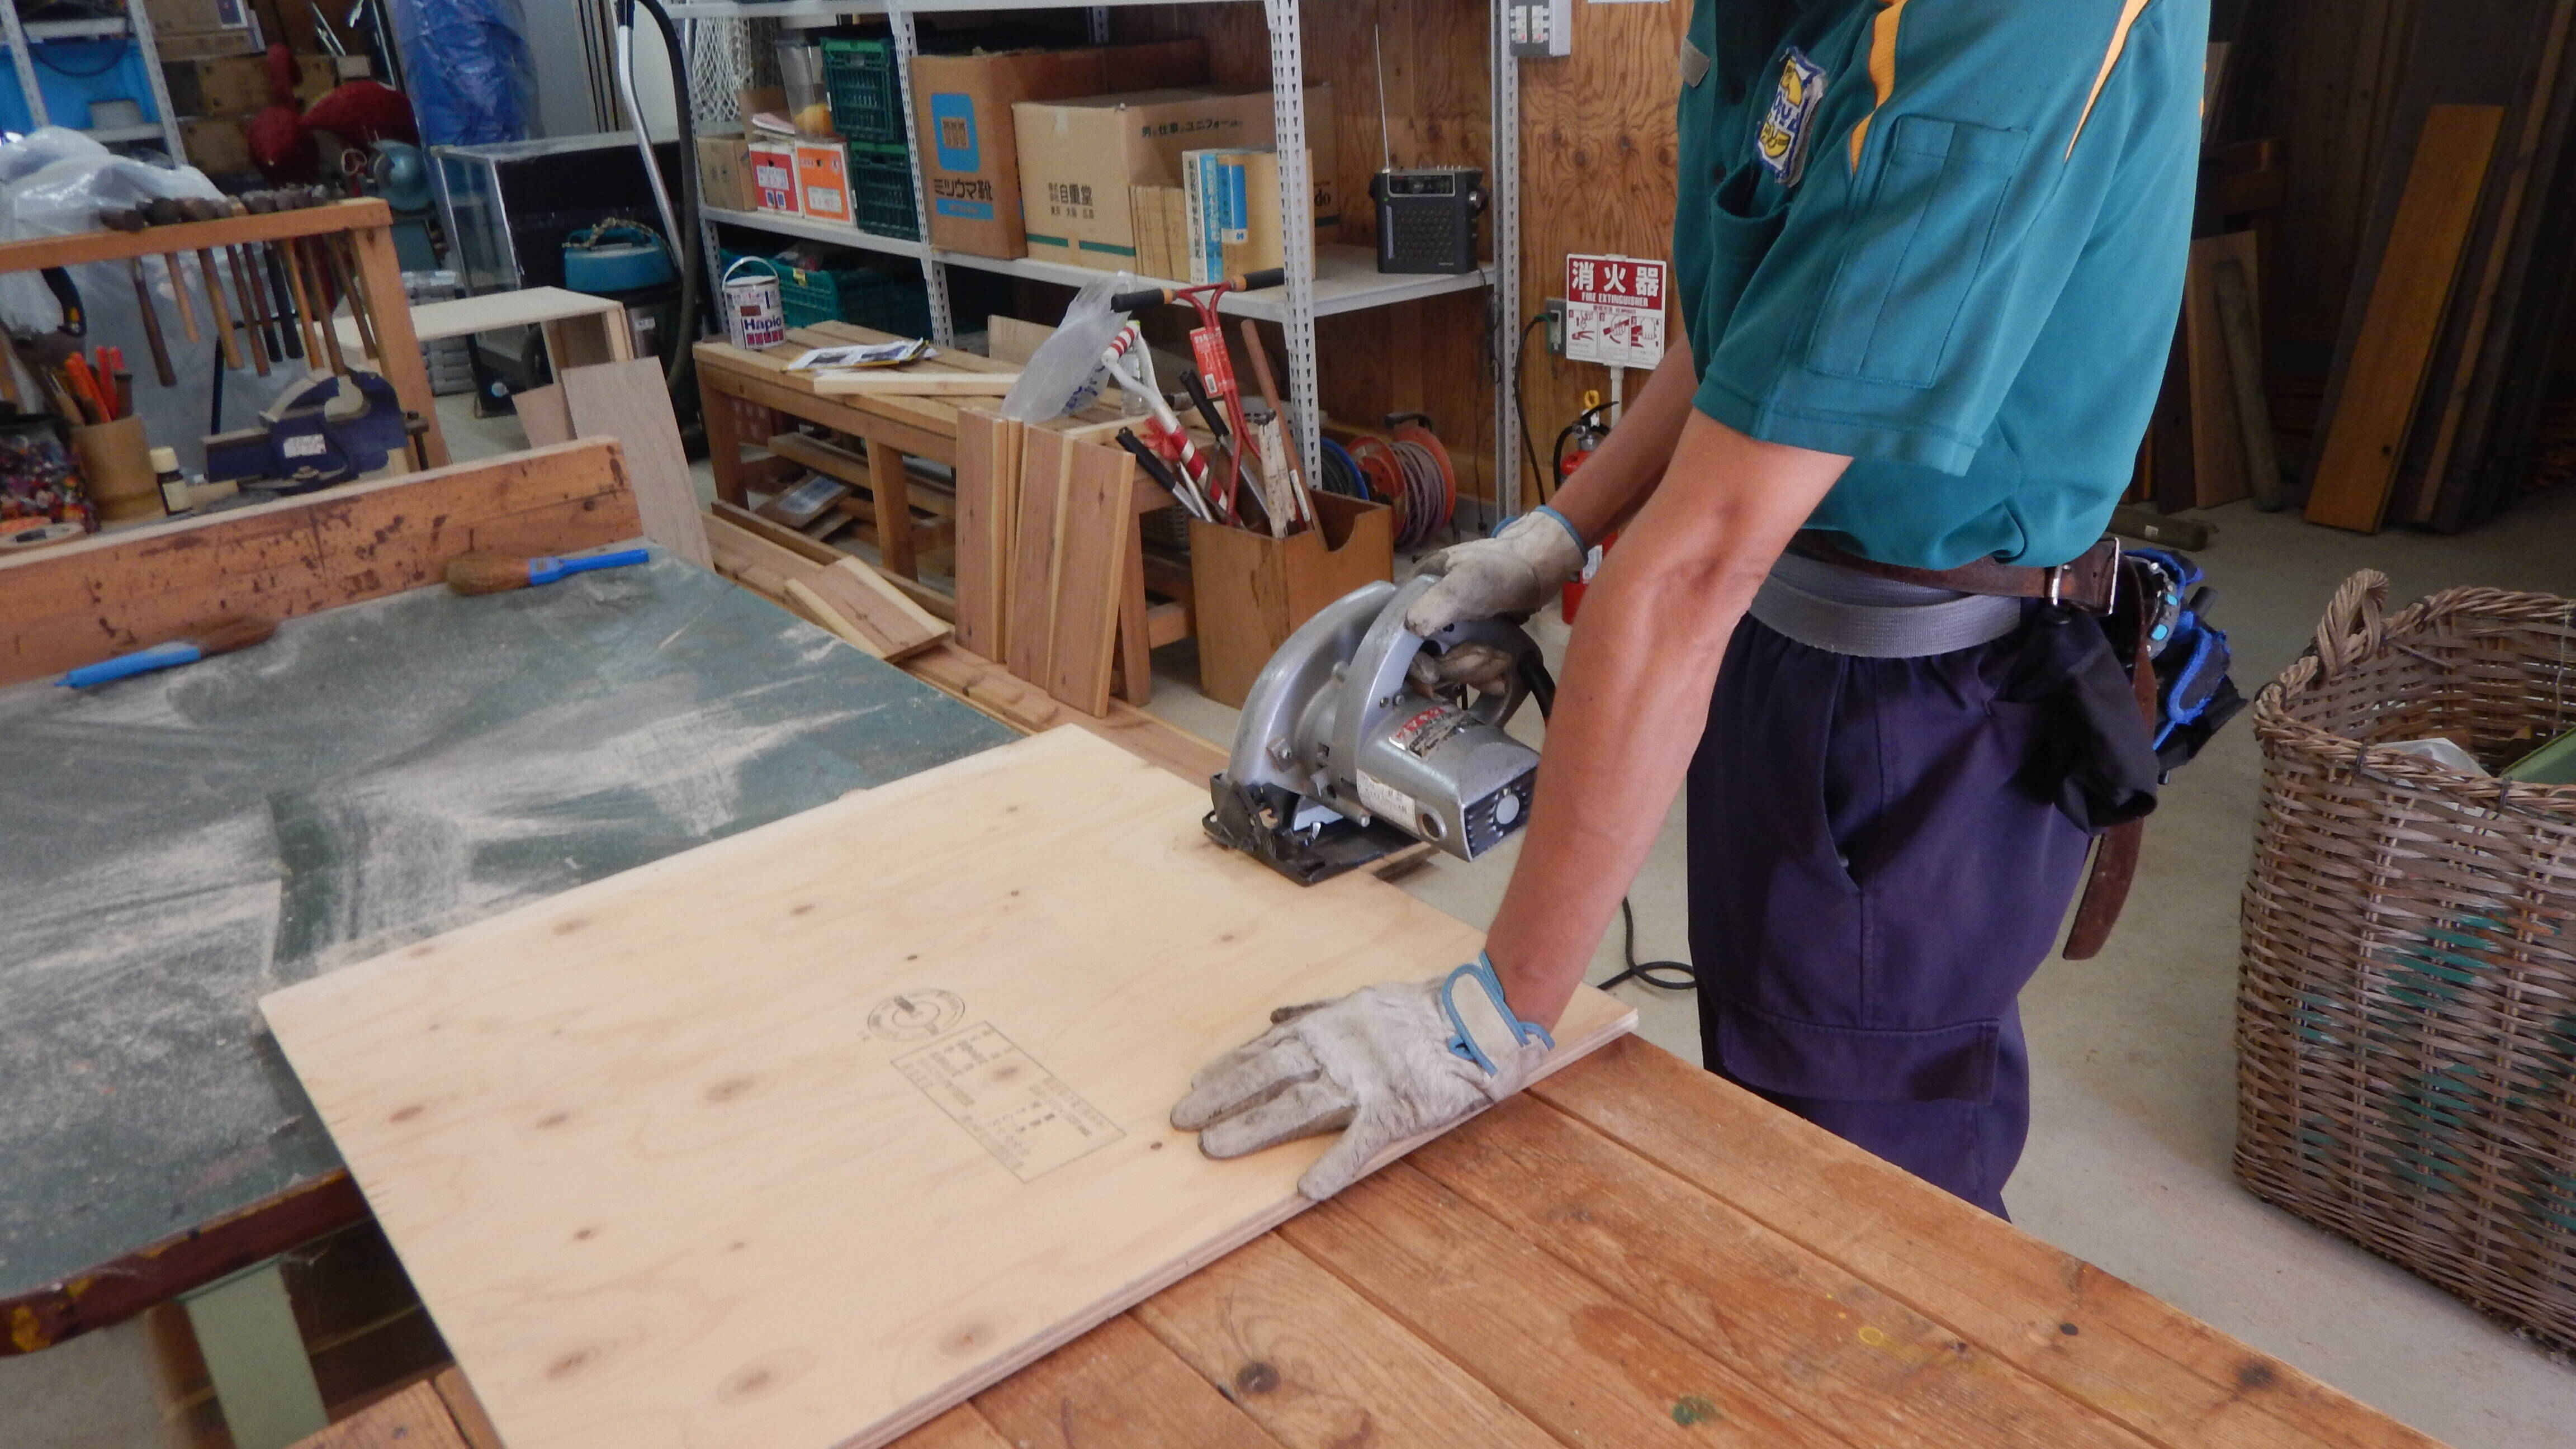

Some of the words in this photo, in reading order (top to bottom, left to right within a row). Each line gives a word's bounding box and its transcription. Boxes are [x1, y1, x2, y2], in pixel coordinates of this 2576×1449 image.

[934, 178, 993, 201] ミツウマ靴
[1314, 188, 1331, 207] do
[1571, 261, 1660, 297] 消火器
[1581, 291, 1597, 302] FIRE
[1598, 292, 1649, 307] EXTINGUISHER
